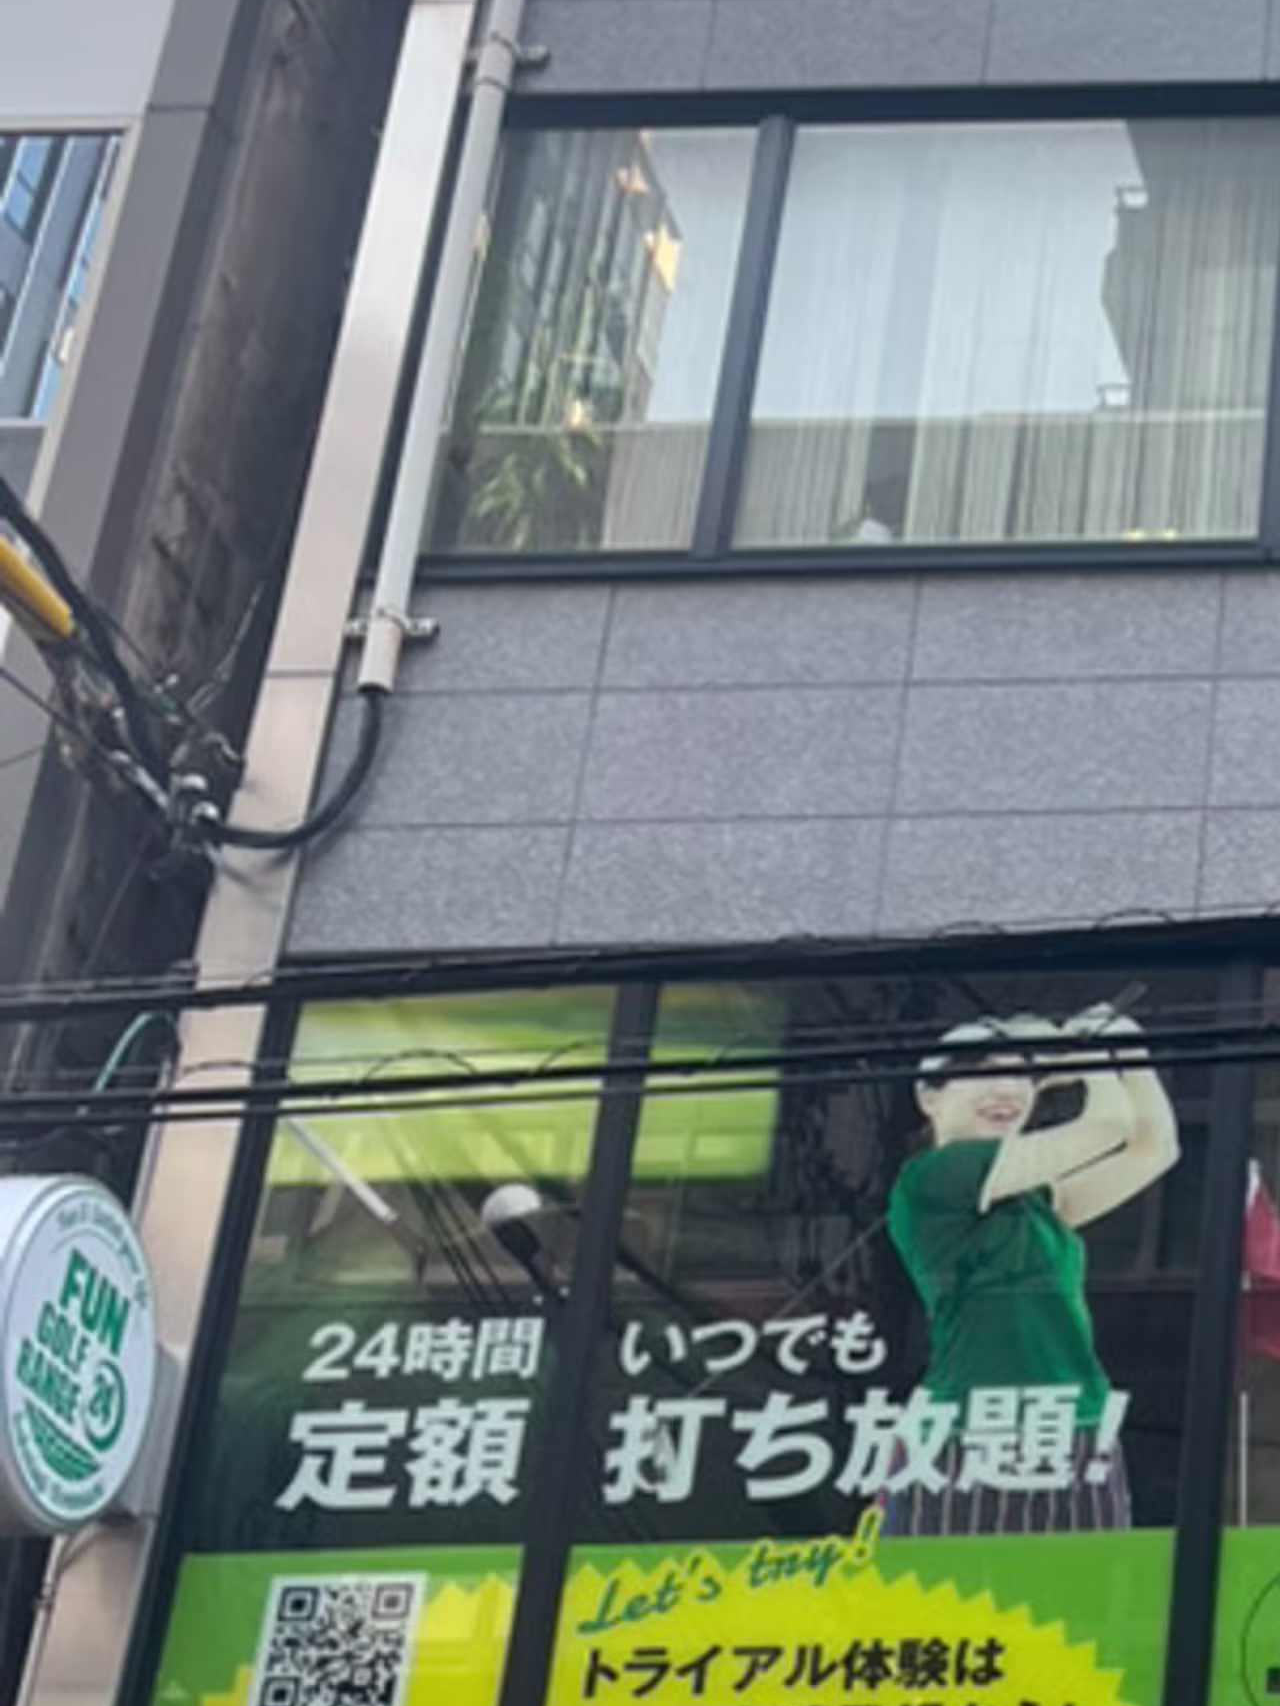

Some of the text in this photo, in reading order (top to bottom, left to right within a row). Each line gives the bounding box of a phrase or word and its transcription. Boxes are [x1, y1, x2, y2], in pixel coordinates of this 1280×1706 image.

[60, 1247, 130, 1357] FUN
[302, 1311, 888, 1381] 24時間 いつでも
[275, 1382, 1130, 1510] 定額 打ち放題!
[576, 1555, 723, 1635] Let's
[581, 1636, 1006, 1700] トライアル体験は
